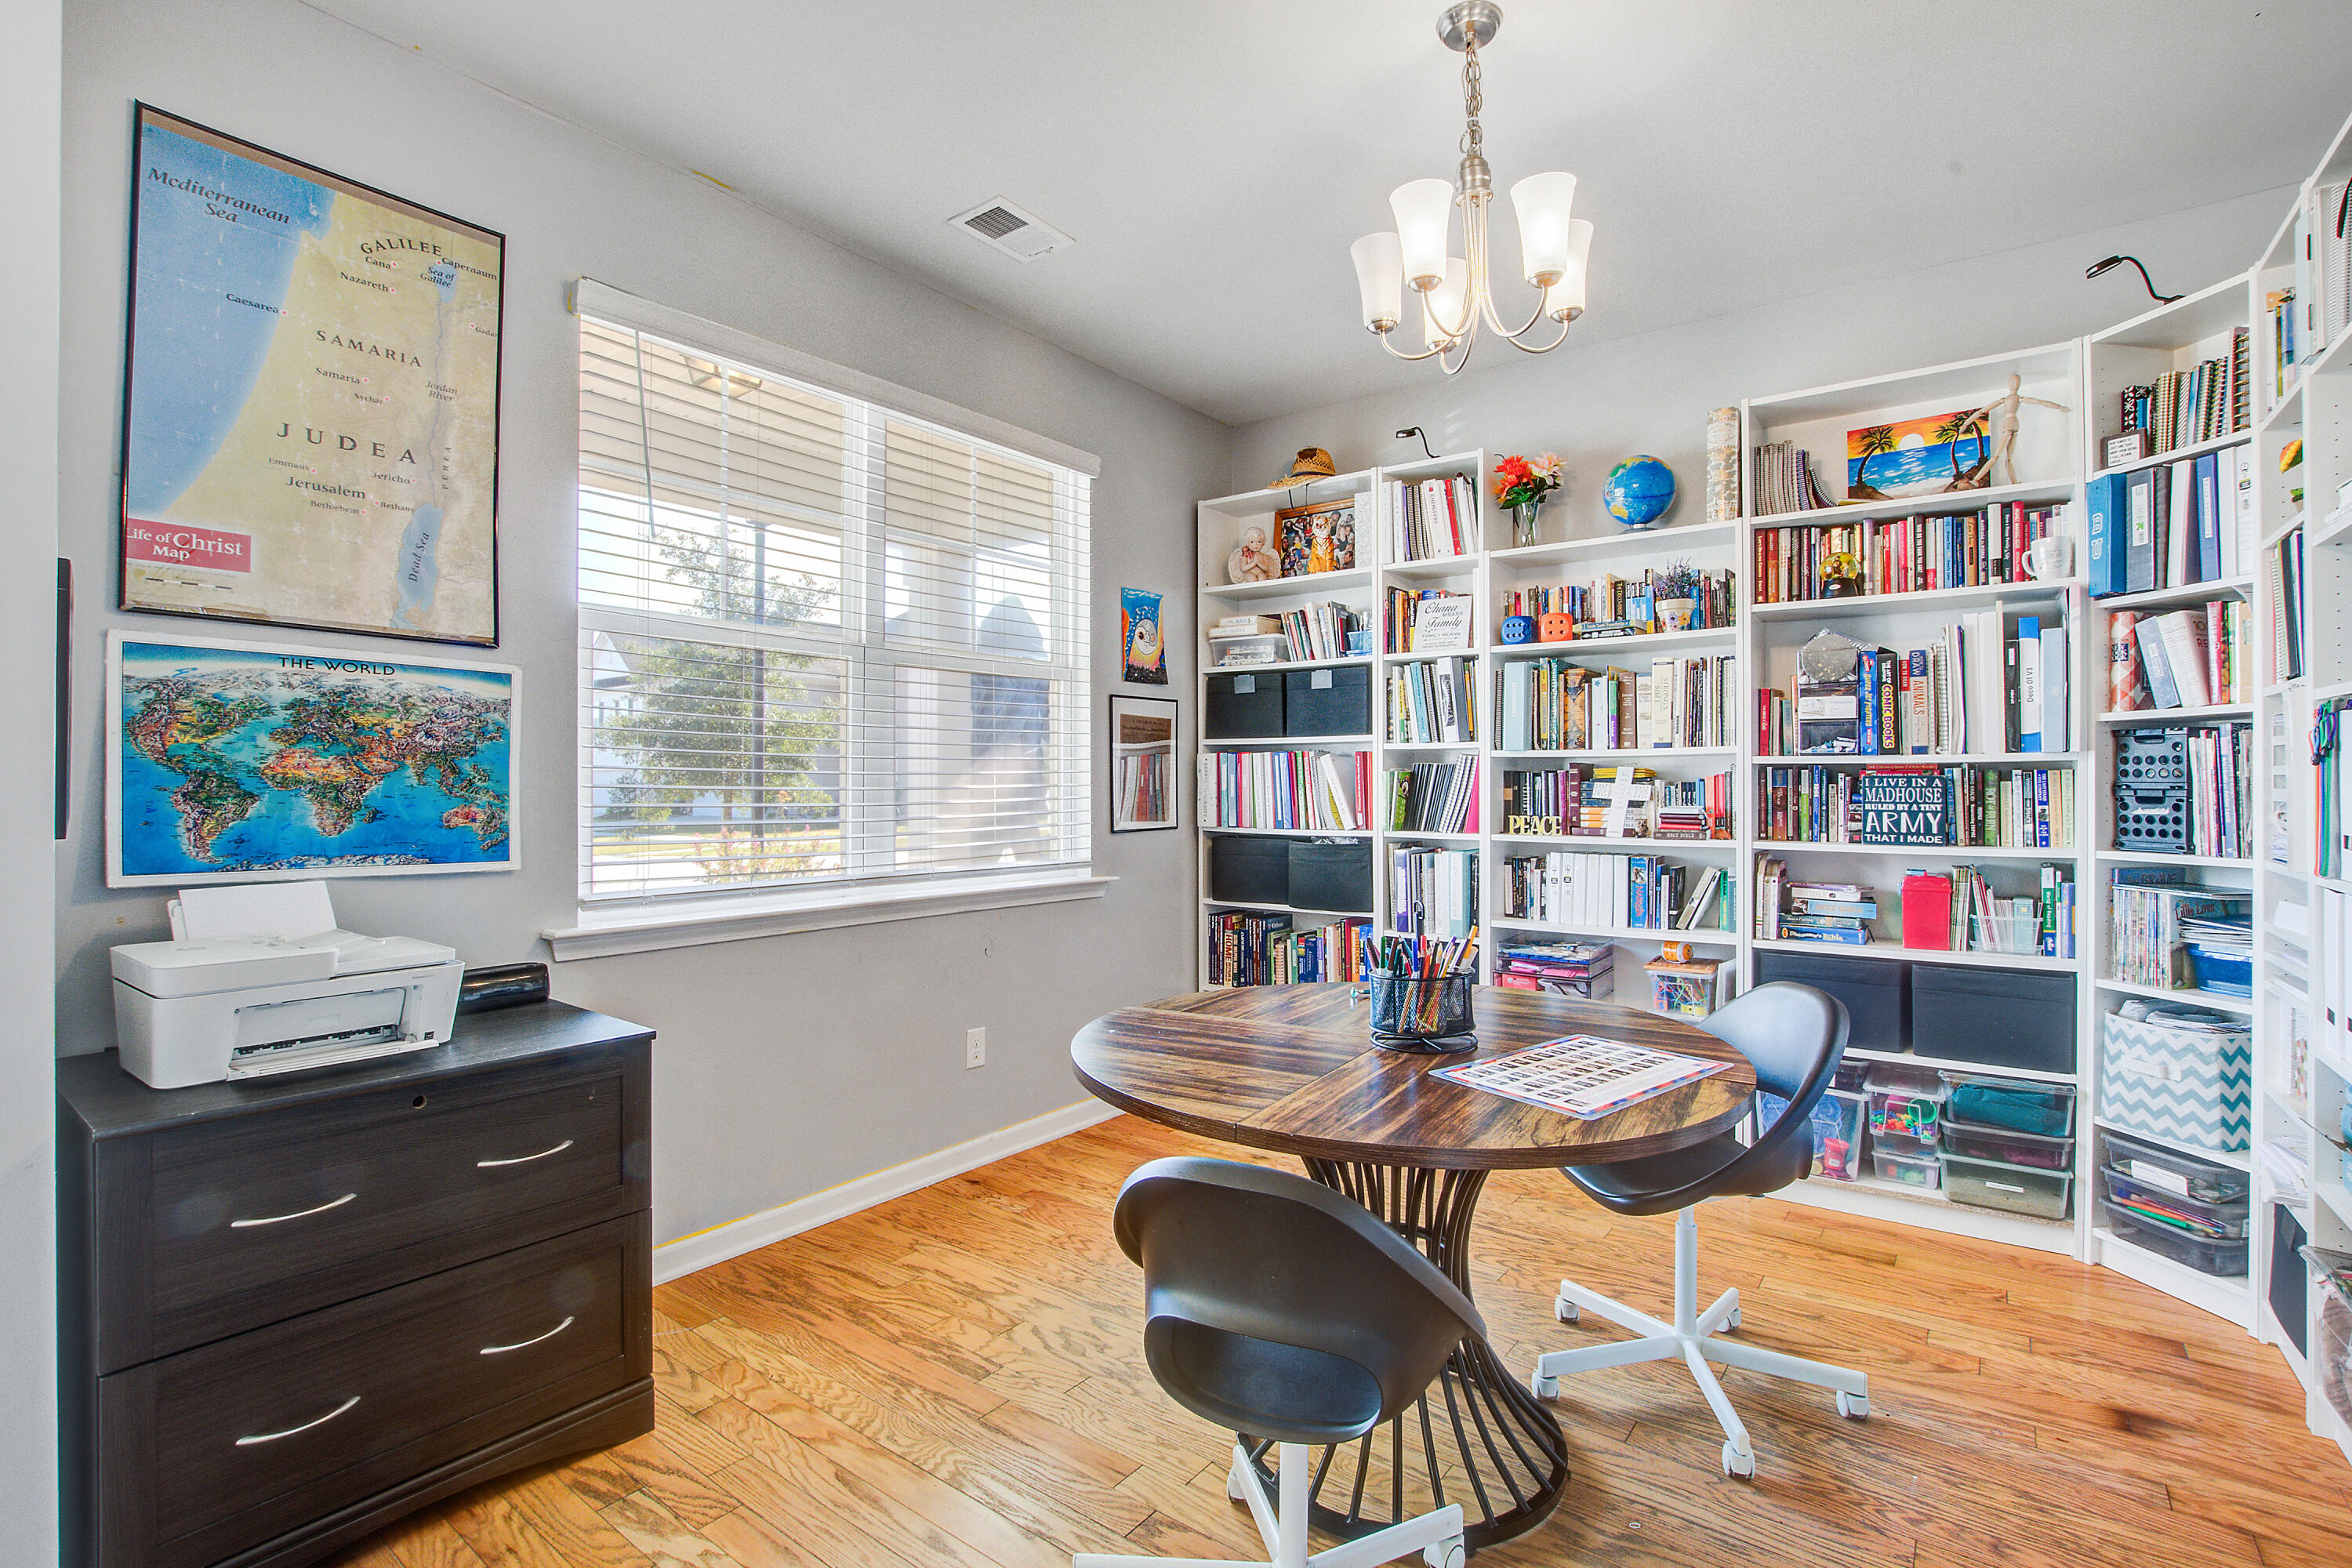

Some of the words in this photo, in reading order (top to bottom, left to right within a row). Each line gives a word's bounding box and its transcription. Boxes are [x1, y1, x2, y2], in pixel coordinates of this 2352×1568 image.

[148, 167, 290, 224] Mediterranean
[205, 202, 238, 223] Sea
[361, 238, 442, 257] GALILEE
[365, 256, 391, 270] Cana
[442, 256, 498, 281] Capernaum
[339, 270, 390, 293] Nazareth
[419, 273, 452, 289] Galilee
[427, 266, 444, 278] Sea
[445, 271, 456, 283] of
[226, 292, 280, 315] Caesarea
[475, 326, 499, 338] Gadar
[316, 329, 423, 368] SAMARIA
[315, 366, 361, 385] Samaria
[425, 380, 459, 396] Jordan
[429, 390, 454, 403] River
[354, 392, 383, 405] Sychar
[277, 422, 417, 465] JUDEA
[268, 457, 310, 471] Emmaus
[442, 445, 452, 491] PEREA
[372, 471, 411, 485] Jericho
[286, 476, 366, 500] Jerusalem
[310, 499, 360, 515] Bethlehem
[379, 501, 416, 514] Bethany
[2092, 512, 2103, 535] B
[126, 527, 153, 541] Life
[155, 532, 172, 544] of
[172, 532, 244, 557] Christ
[2091, 537, 2103, 561] U
[151, 545, 191, 562] Map
[408, 552, 424, 583] Dead
[416, 532, 430, 552] Sea
[1425, 601, 1458, 614] Ohana
[1425, 615, 1462, 629] Family
[278, 657, 315, 670] THE
[323, 660, 396, 677] WORLD
[1911, 652, 1920, 676] DRAW
[2027, 666, 2034, 677] V3
[1882, 684, 1894, 714] COMIC
[1912, 680, 1925, 716] ANIMALS
[1882, 715, 1895, 749] BOOKS
[1864, 778, 1869, 786] I
[1874, 778, 1907, 787] LIVE
[1911, 778, 1928, 787] IN
[1932, 778, 1943, 787] A
[1864, 787, 1943, 803] MADHOUSE
[1985, 787, 1996, 804] ROT
[1508, 815, 1563, 836] PEACE
[1865, 811, 1942, 834] ARMY
[1985, 810, 1996, 831] RUIN
[1864, 833, 1897, 843] THAT
[1907, 835, 1944, 844] MADE
[1635, 885, 1645, 917] NARNIA
[1838, 905, 1864, 913] BIBLE
[1823, 932, 1844, 942] Bible
